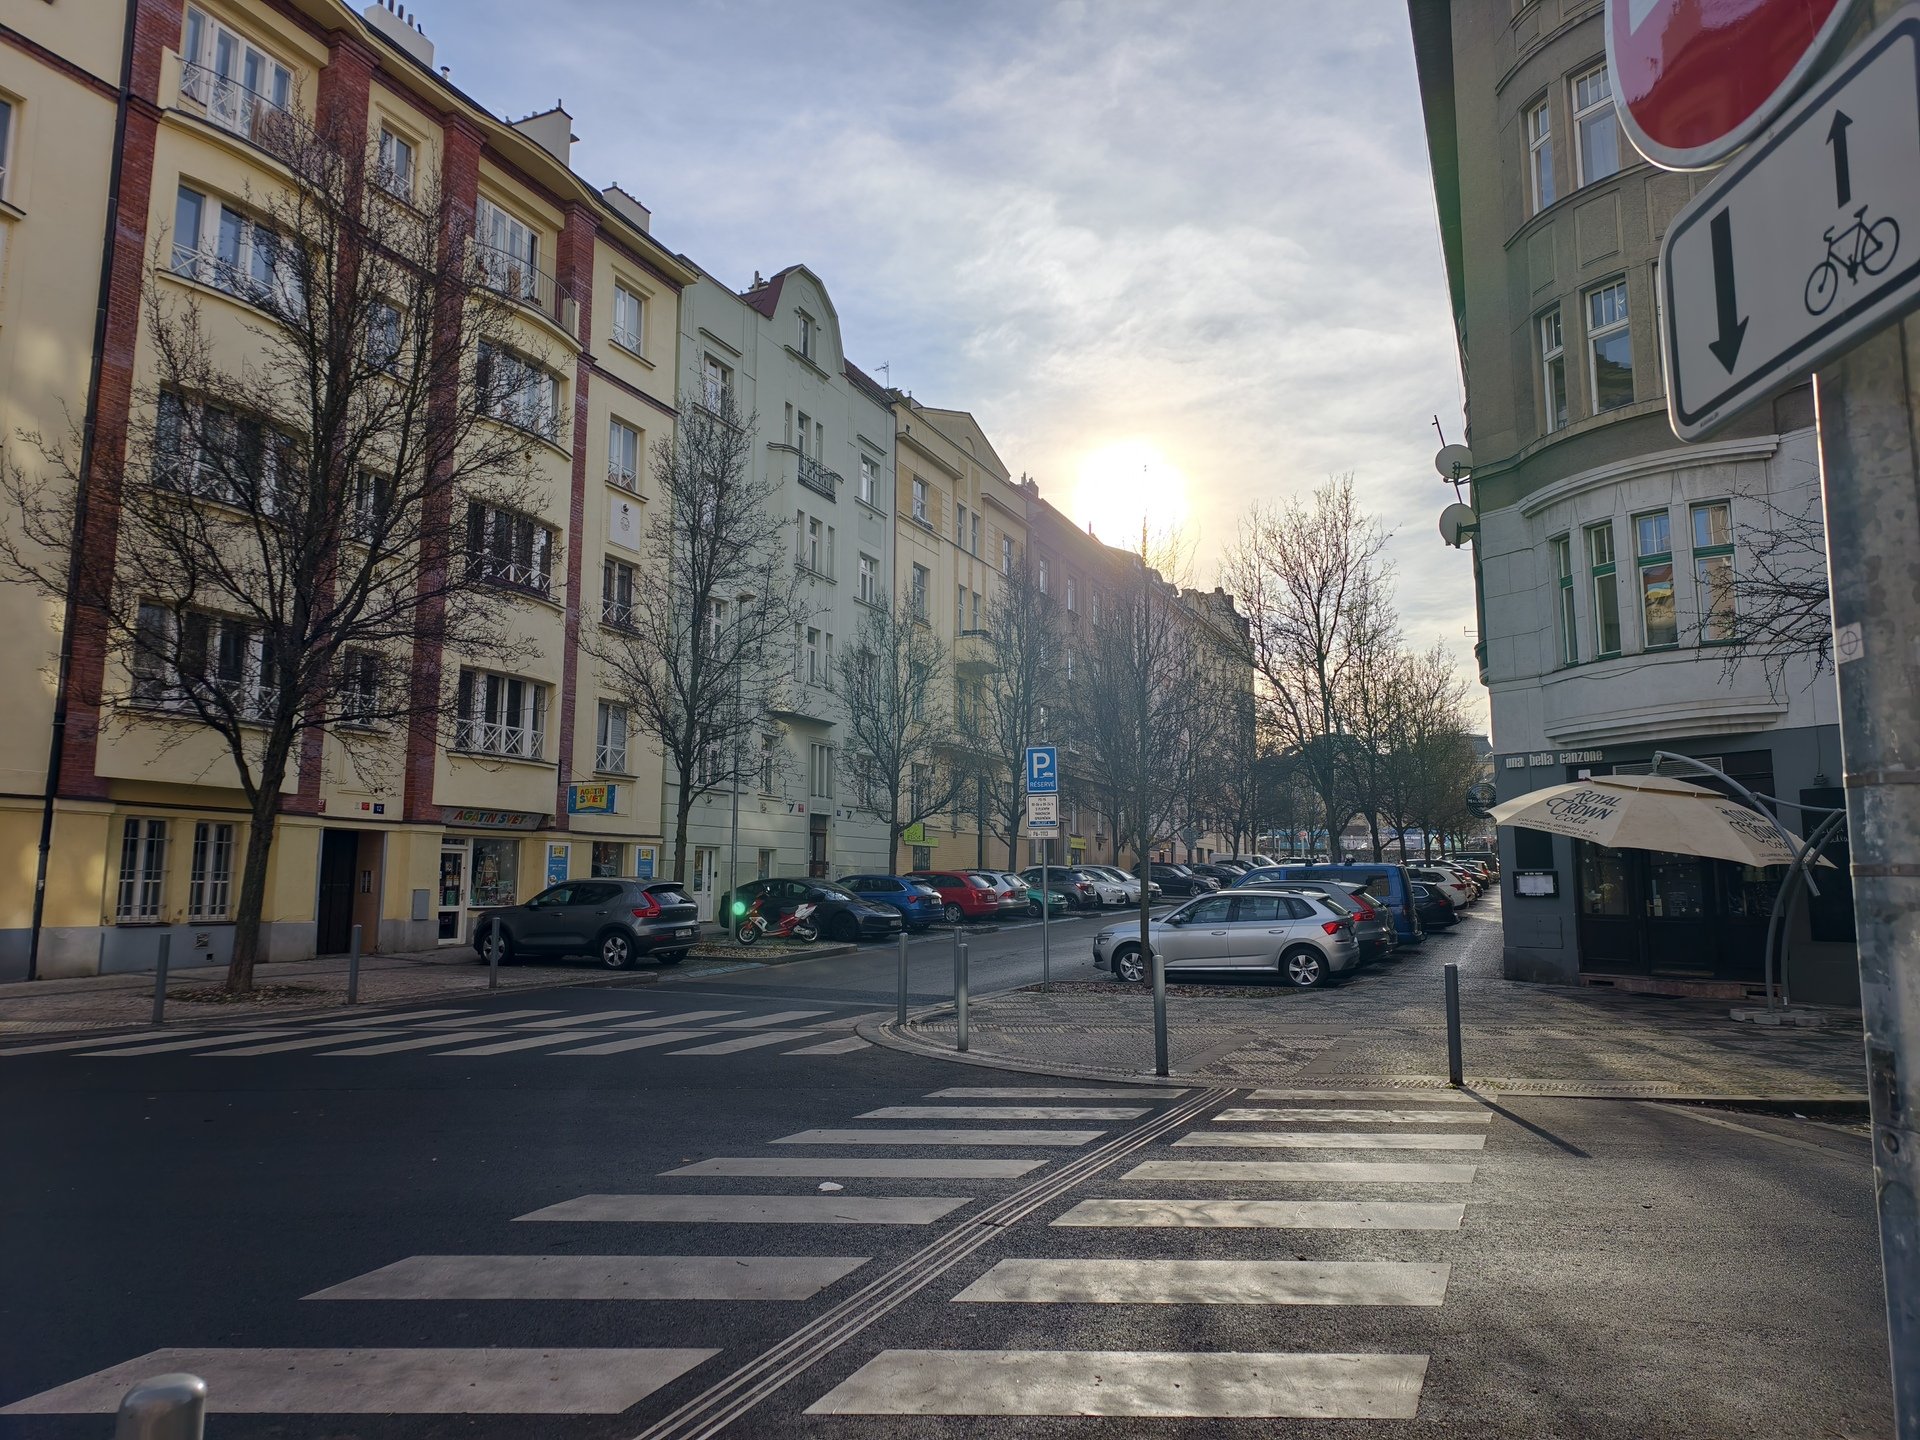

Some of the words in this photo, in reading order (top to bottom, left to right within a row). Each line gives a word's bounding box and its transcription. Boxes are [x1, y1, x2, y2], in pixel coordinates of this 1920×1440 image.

[1033, 753, 1050, 778] P
[1506, 757, 1524, 768] una
[1529, 753, 1553, 766] bella
[1560, 750, 1603, 764] canzone
[1030, 780, 1055, 788] RÉSERVÉ
[1574, 790, 1622, 807] ROYAL
[1546, 798, 1613, 820] CROWN
[1555, 814, 1588, 824] Cola
